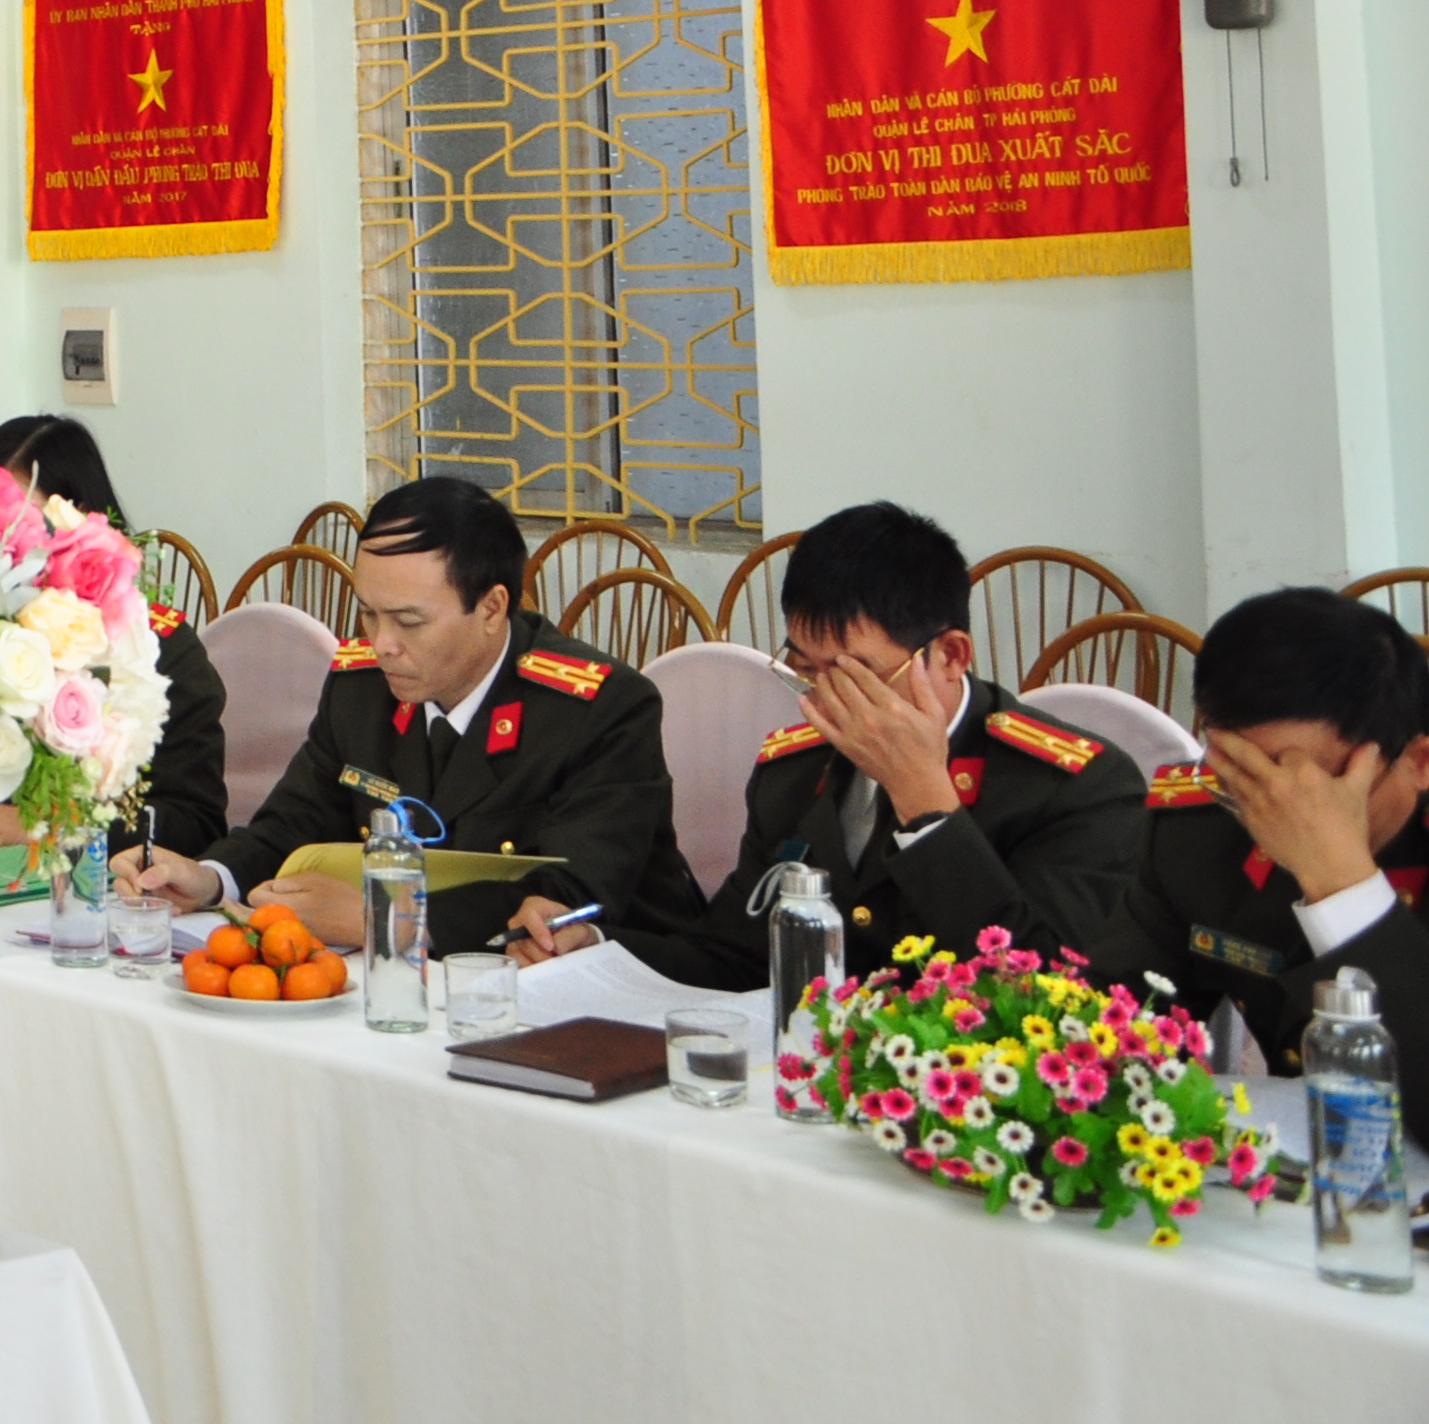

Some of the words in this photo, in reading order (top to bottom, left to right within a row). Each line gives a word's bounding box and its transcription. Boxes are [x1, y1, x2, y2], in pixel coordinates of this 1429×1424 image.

[826, 98, 863, 119] NHÂN
[871, 94, 900, 114] DÂN
[926, 88, 959, 108] CÁN
[985, 80, 1044, 102] PHƯỜNG
[1050, 75, 1082, 97] CÁT
[1089, 73, 1118, 94] DÀI
[873, 120, 908, 139] QUẬN
[913, 117, 929, 135] LÊ
[934, 113, 975, 132] CHÂN
[1030, 106, 1077, 124] PHÒNG
[825, 150, 873, 175] ĐƠN
[879, 149, 900, 175] VỊ
[908, 145, 942, 169] THI
[951, 141, 992, 165] ĐUA
[998, 130, 1063, 162] XUẤT
[1075, 128, 1132, 157] SẮC
[797, 187, 843, 204] PHONG
[849, 182, 886, 201] TRÀO
[889, 178, 926, 198] TOÀN
[931, 175, 960, 195] DÂN
[1018, 172, 1039, 188] AN
[1045, 170, 1082, 187] NINH
[927, 200, 975, 217] NĂM
